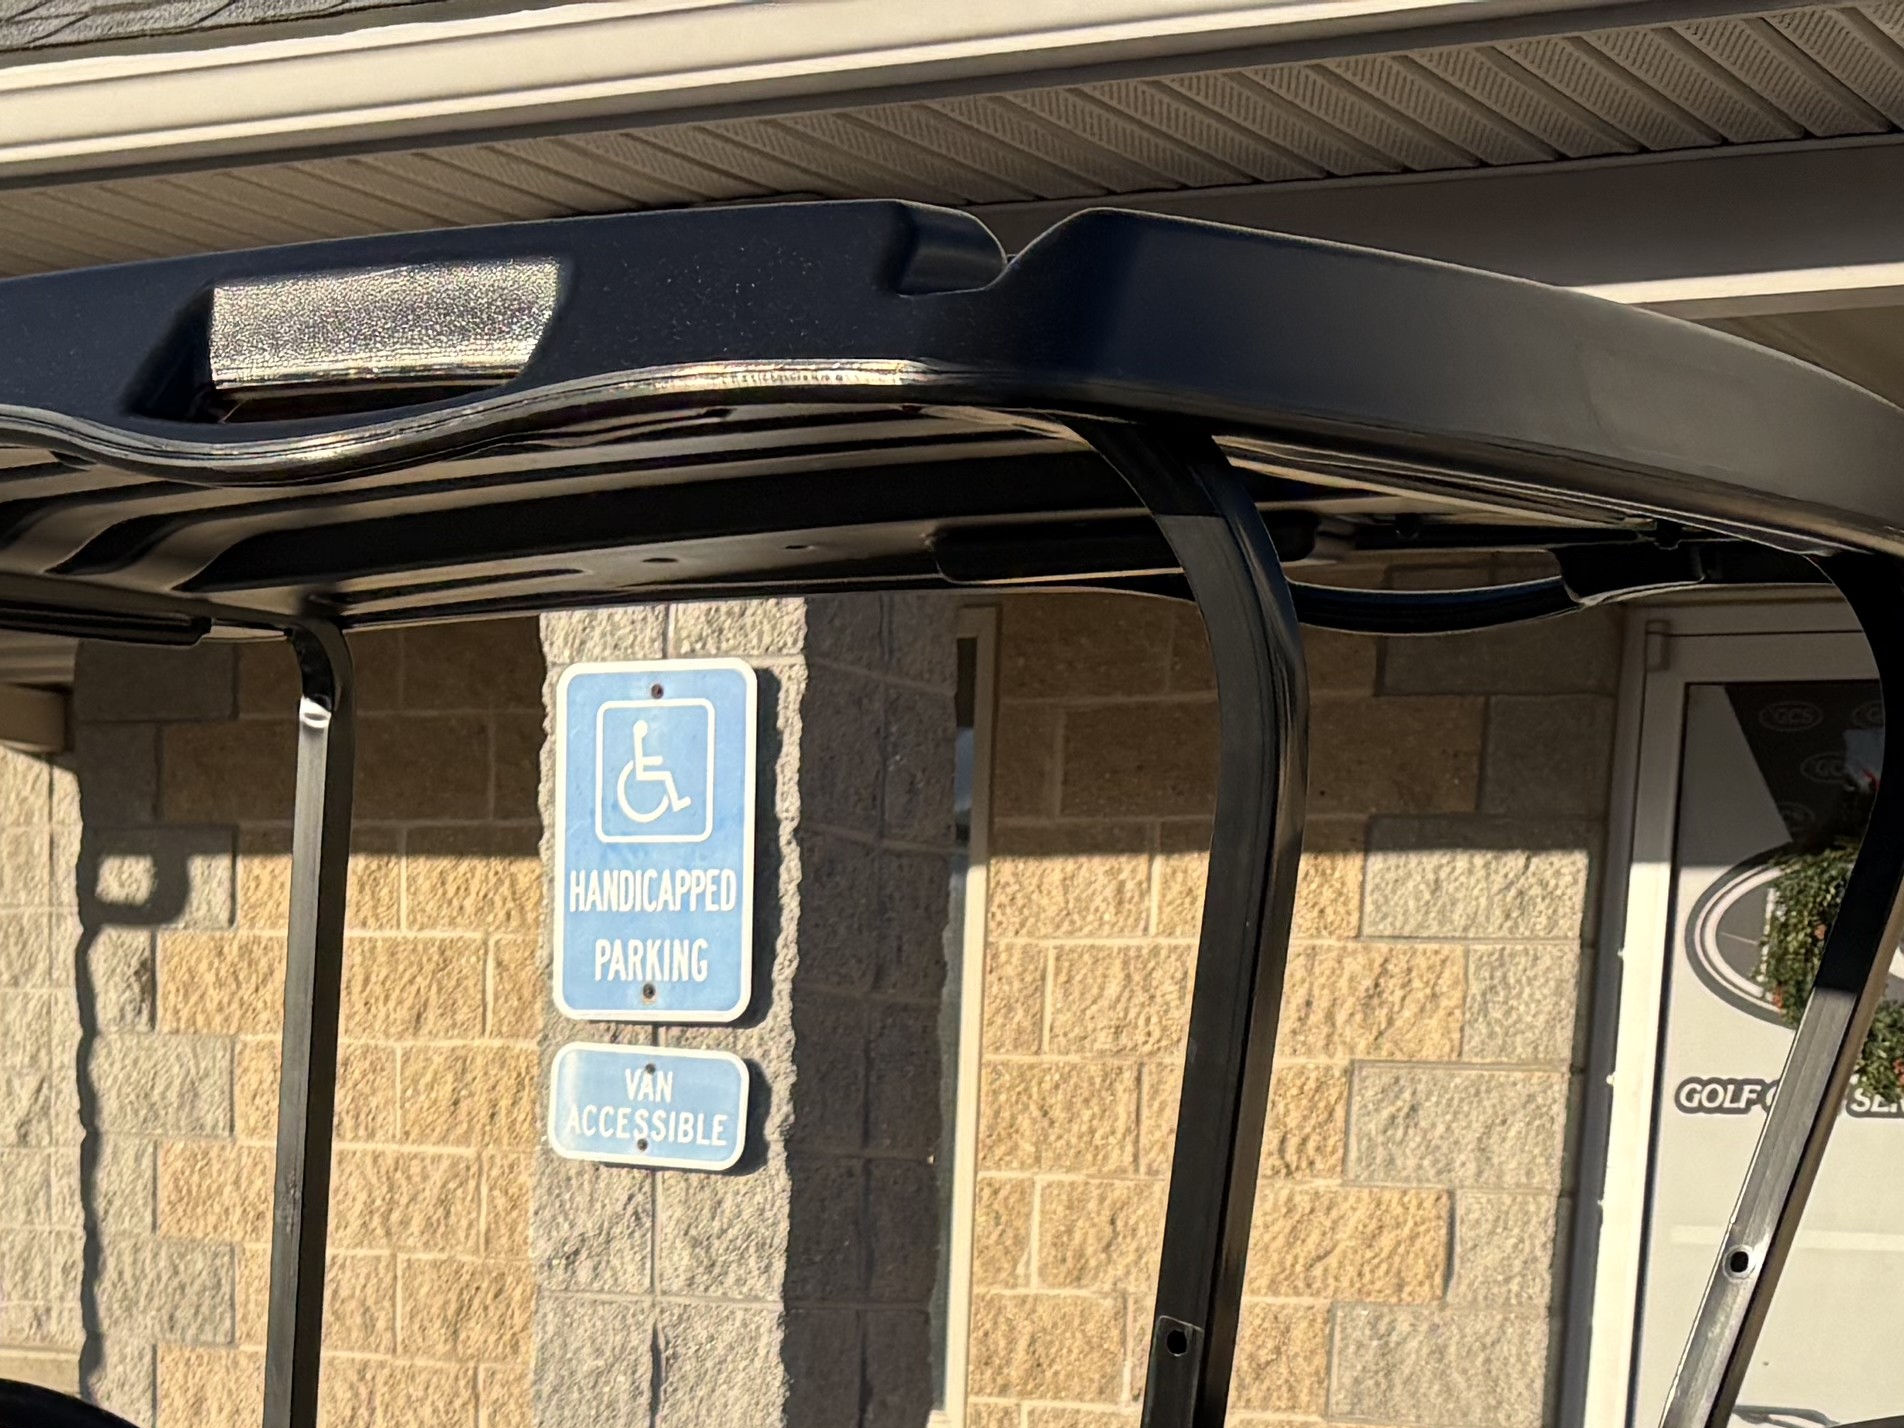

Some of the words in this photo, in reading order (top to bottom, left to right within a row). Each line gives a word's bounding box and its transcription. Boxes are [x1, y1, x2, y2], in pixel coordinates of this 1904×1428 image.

[569, 867, 737, 913] HANDICAPPED
[594, 937, 709, 983] PARKING
[624, 1067, 673, 1104] VAN
[1679, 1082, 1762, 1109] GOLF
[564, 1104, 728, 1147] ACCESSIBLE
